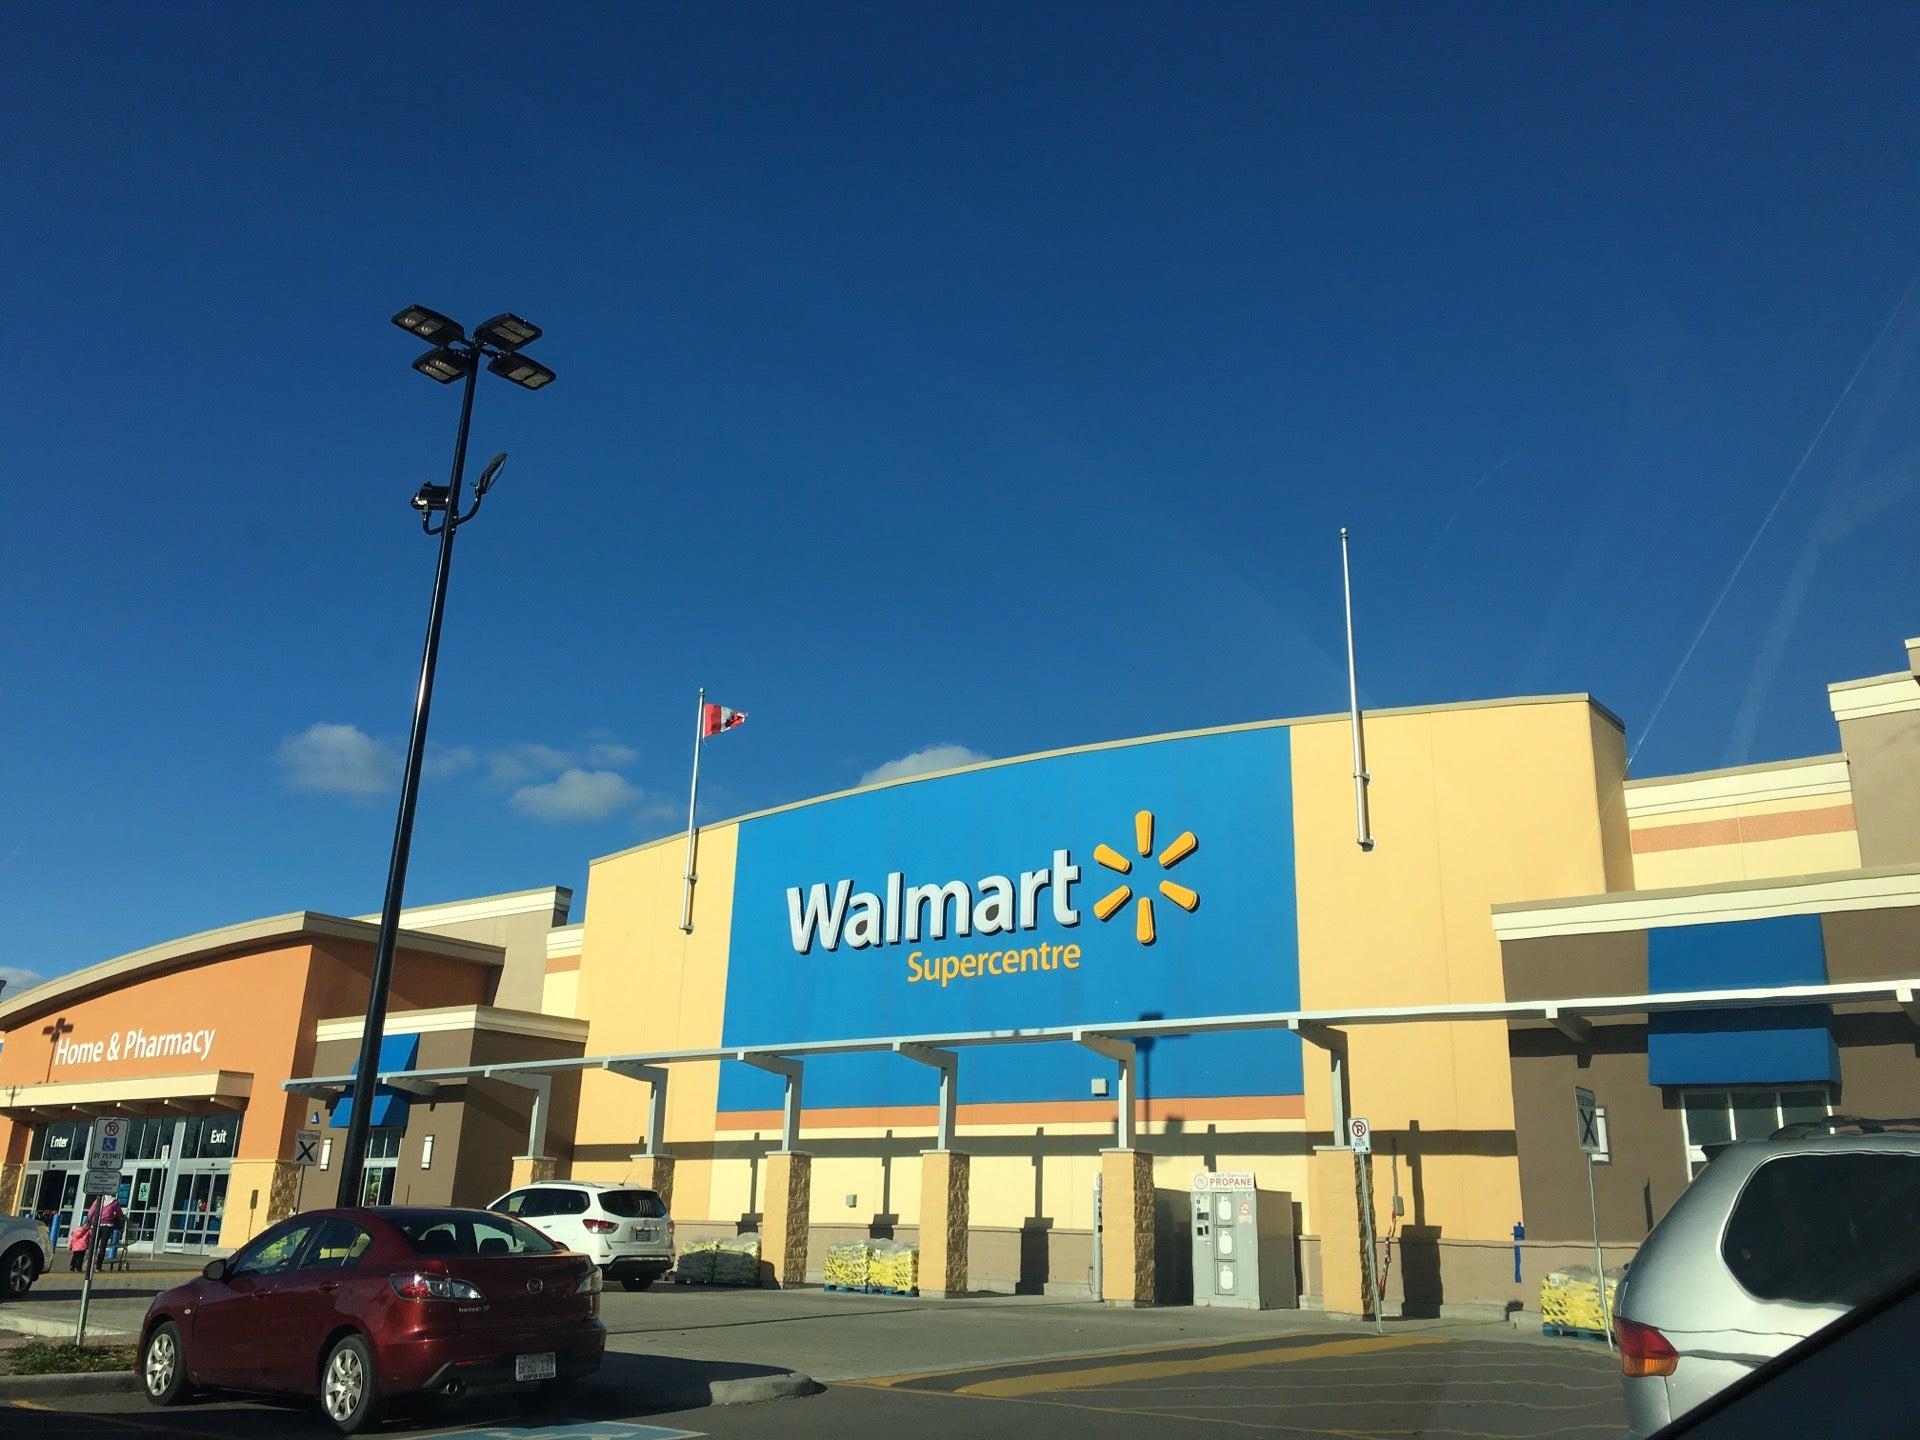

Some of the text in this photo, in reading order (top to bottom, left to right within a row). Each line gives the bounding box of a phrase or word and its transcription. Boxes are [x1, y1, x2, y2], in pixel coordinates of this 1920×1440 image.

[786, 848, 1080, 955] Walmart
[907, 942, 1081, 988] Supercentre
[54, 1028, 216, 1066] Home & Pharmacy
[50, 1136, 68, 1148] Enter
[210, 1130, 227, 1143] Exit
[1209, 1178, 1253, 1186] PROPANE
